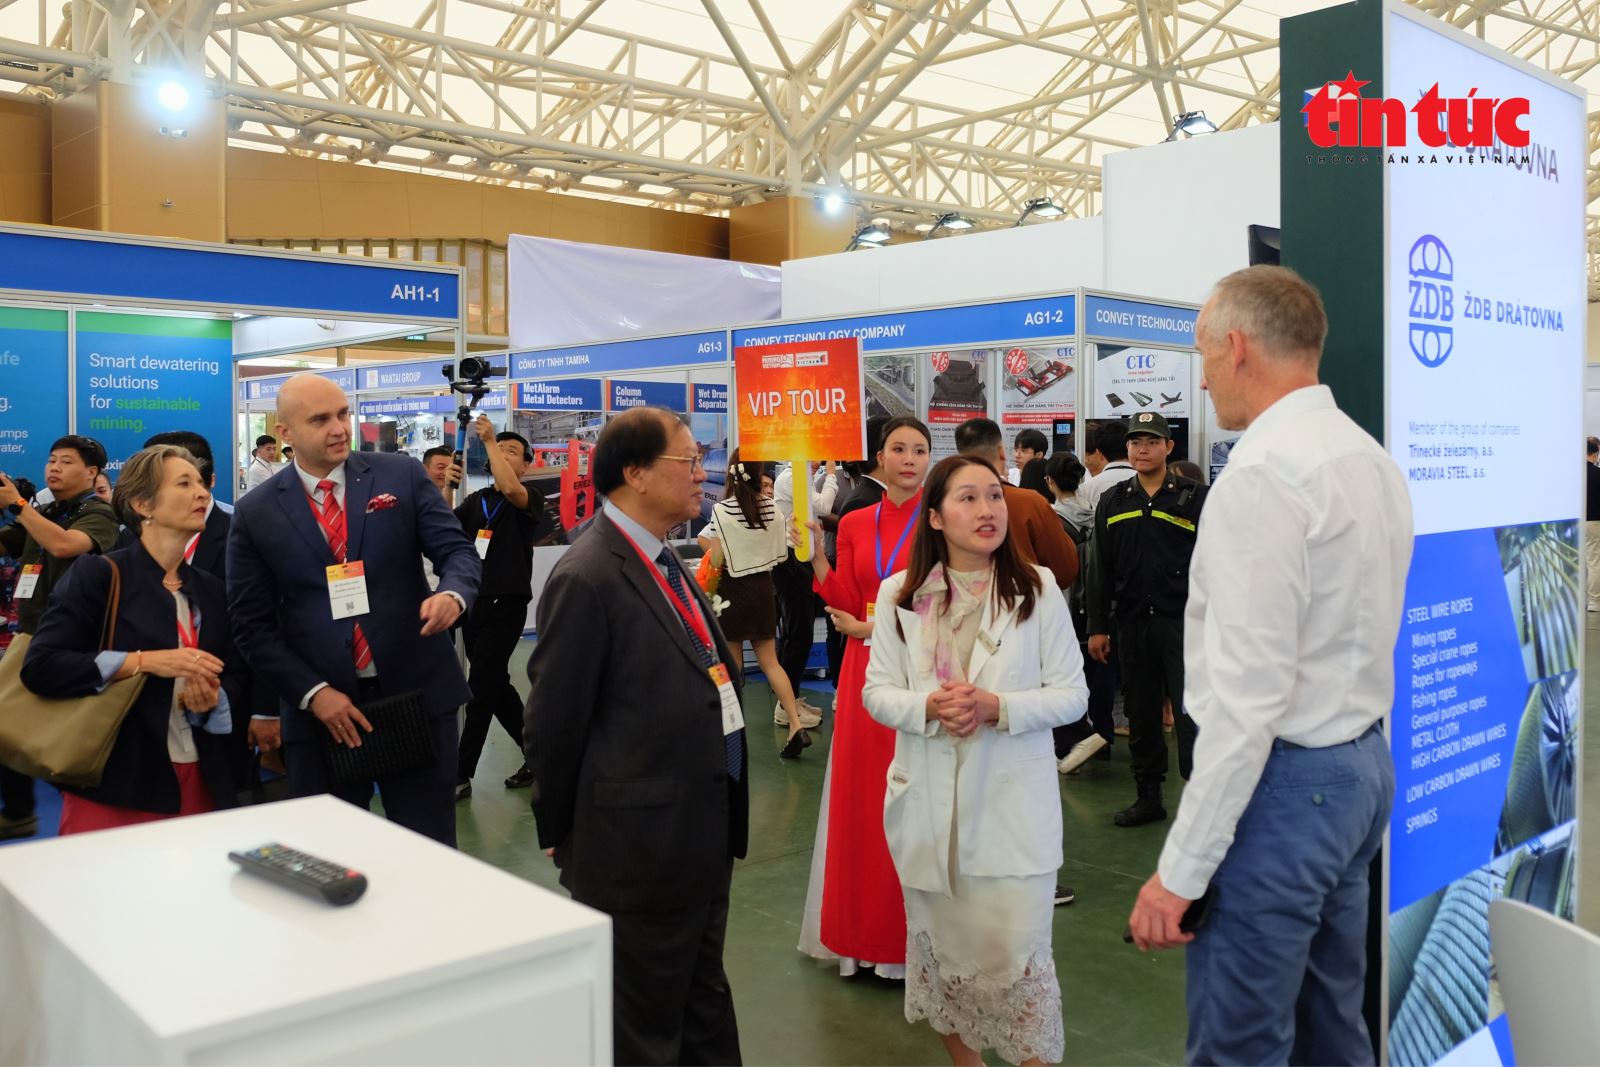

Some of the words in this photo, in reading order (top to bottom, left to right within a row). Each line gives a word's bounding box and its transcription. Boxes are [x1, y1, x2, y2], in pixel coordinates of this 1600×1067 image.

[391, 284, 440, 303] AH1-1
[1024, 310, 1063, 326] AG1-2
[1464, 290, 1491, 321] ŽDB
[1496, 299, 1564, 332] DRÁTOVNA
[1096, 309, 1135, 326] CONVEY
[1136, 314, 1195, 333] TECHNOLOGY
[853, 324, 906, 340] COMPANY
[697, 341, 722, 354] AG1-3
[1057, 347, 1075, 357] CTC
[90, 353, 136, 368] Smart
[140, 355, 219, 375] dewatering
[518, 356, 536, 370] CÔNG
[538, 358, 546, 368] TY
[546, 356, 564, 368] TNHH
[565, 354, 590, 366] TAMIHA
[1126, 354, 1155, 369] CTC
[90, 374, 159, 390] solutions
[402, 371, 421, 383] GROUP
[523, 382, 560, 394] MetAlarm
[615, 385, 642, 397] Column
[698, 389, 710, 398] Wet
[90, 394, 112, 409] for
[116, 396, 200, 411] sustainable
[523, 393, 545, 404] Metal
[547, 393, 583, 406] Detectors
[615, 396, 646, 407] Flotation
[748, 391, 782, 417] VIP
[787, 388, 846, 415] TOUR
[90, 416, 147, 433] mining.
[1409, 421, 1438, 435] Member
[0, 444, 25, 454] ater,
[1409, 467, 1445, 481] MORAVIA
[1407, 606, 1430, 624] STEEL
[1431, 601, 1449, 619] WIRE
[1451, 597, 1473, 614] ROPES
[1412, 631, 1435, 648] Mining
[1437, 627, 1456, 644] ropes
[1412, 650, 1438, 670] Special
[1439, 647, 1458, 661] crane
[1459, 641, 1478, 657] ropes
[1412, 671, 1434, 689] Ropes
[1435, 667, 1445, 681] for
[1446, 661, 1478, 680] ropeways
[1412, 691, 1437, 709] Fishing
[1438, 685, 1457, 702] ropes
[1412, 711, 1440, 730] General
[1441, 701, 1468, 720] purpose
[1469, 696, 1487, 712] ropes
[1412, 731, 1435, 750] METAL
[1436, 722, 1459, 742] CLOTH
[1411, 753, 1430, 770] HIGH
[1432, 741, 1460, 763] CARBON
[1461, 732, 1486, 751] DRAWN
[1486, 723, 1506, 742] WIRES
[1406, 784, 1423, 803] LOW
[1425, 770, 1454, 795] CARBON
[1455, 762, 1479, 784] DRAWN
[1480, 753, 1500, 774] WIRES
[1406, 807, 1438, 834] SPRINGS
